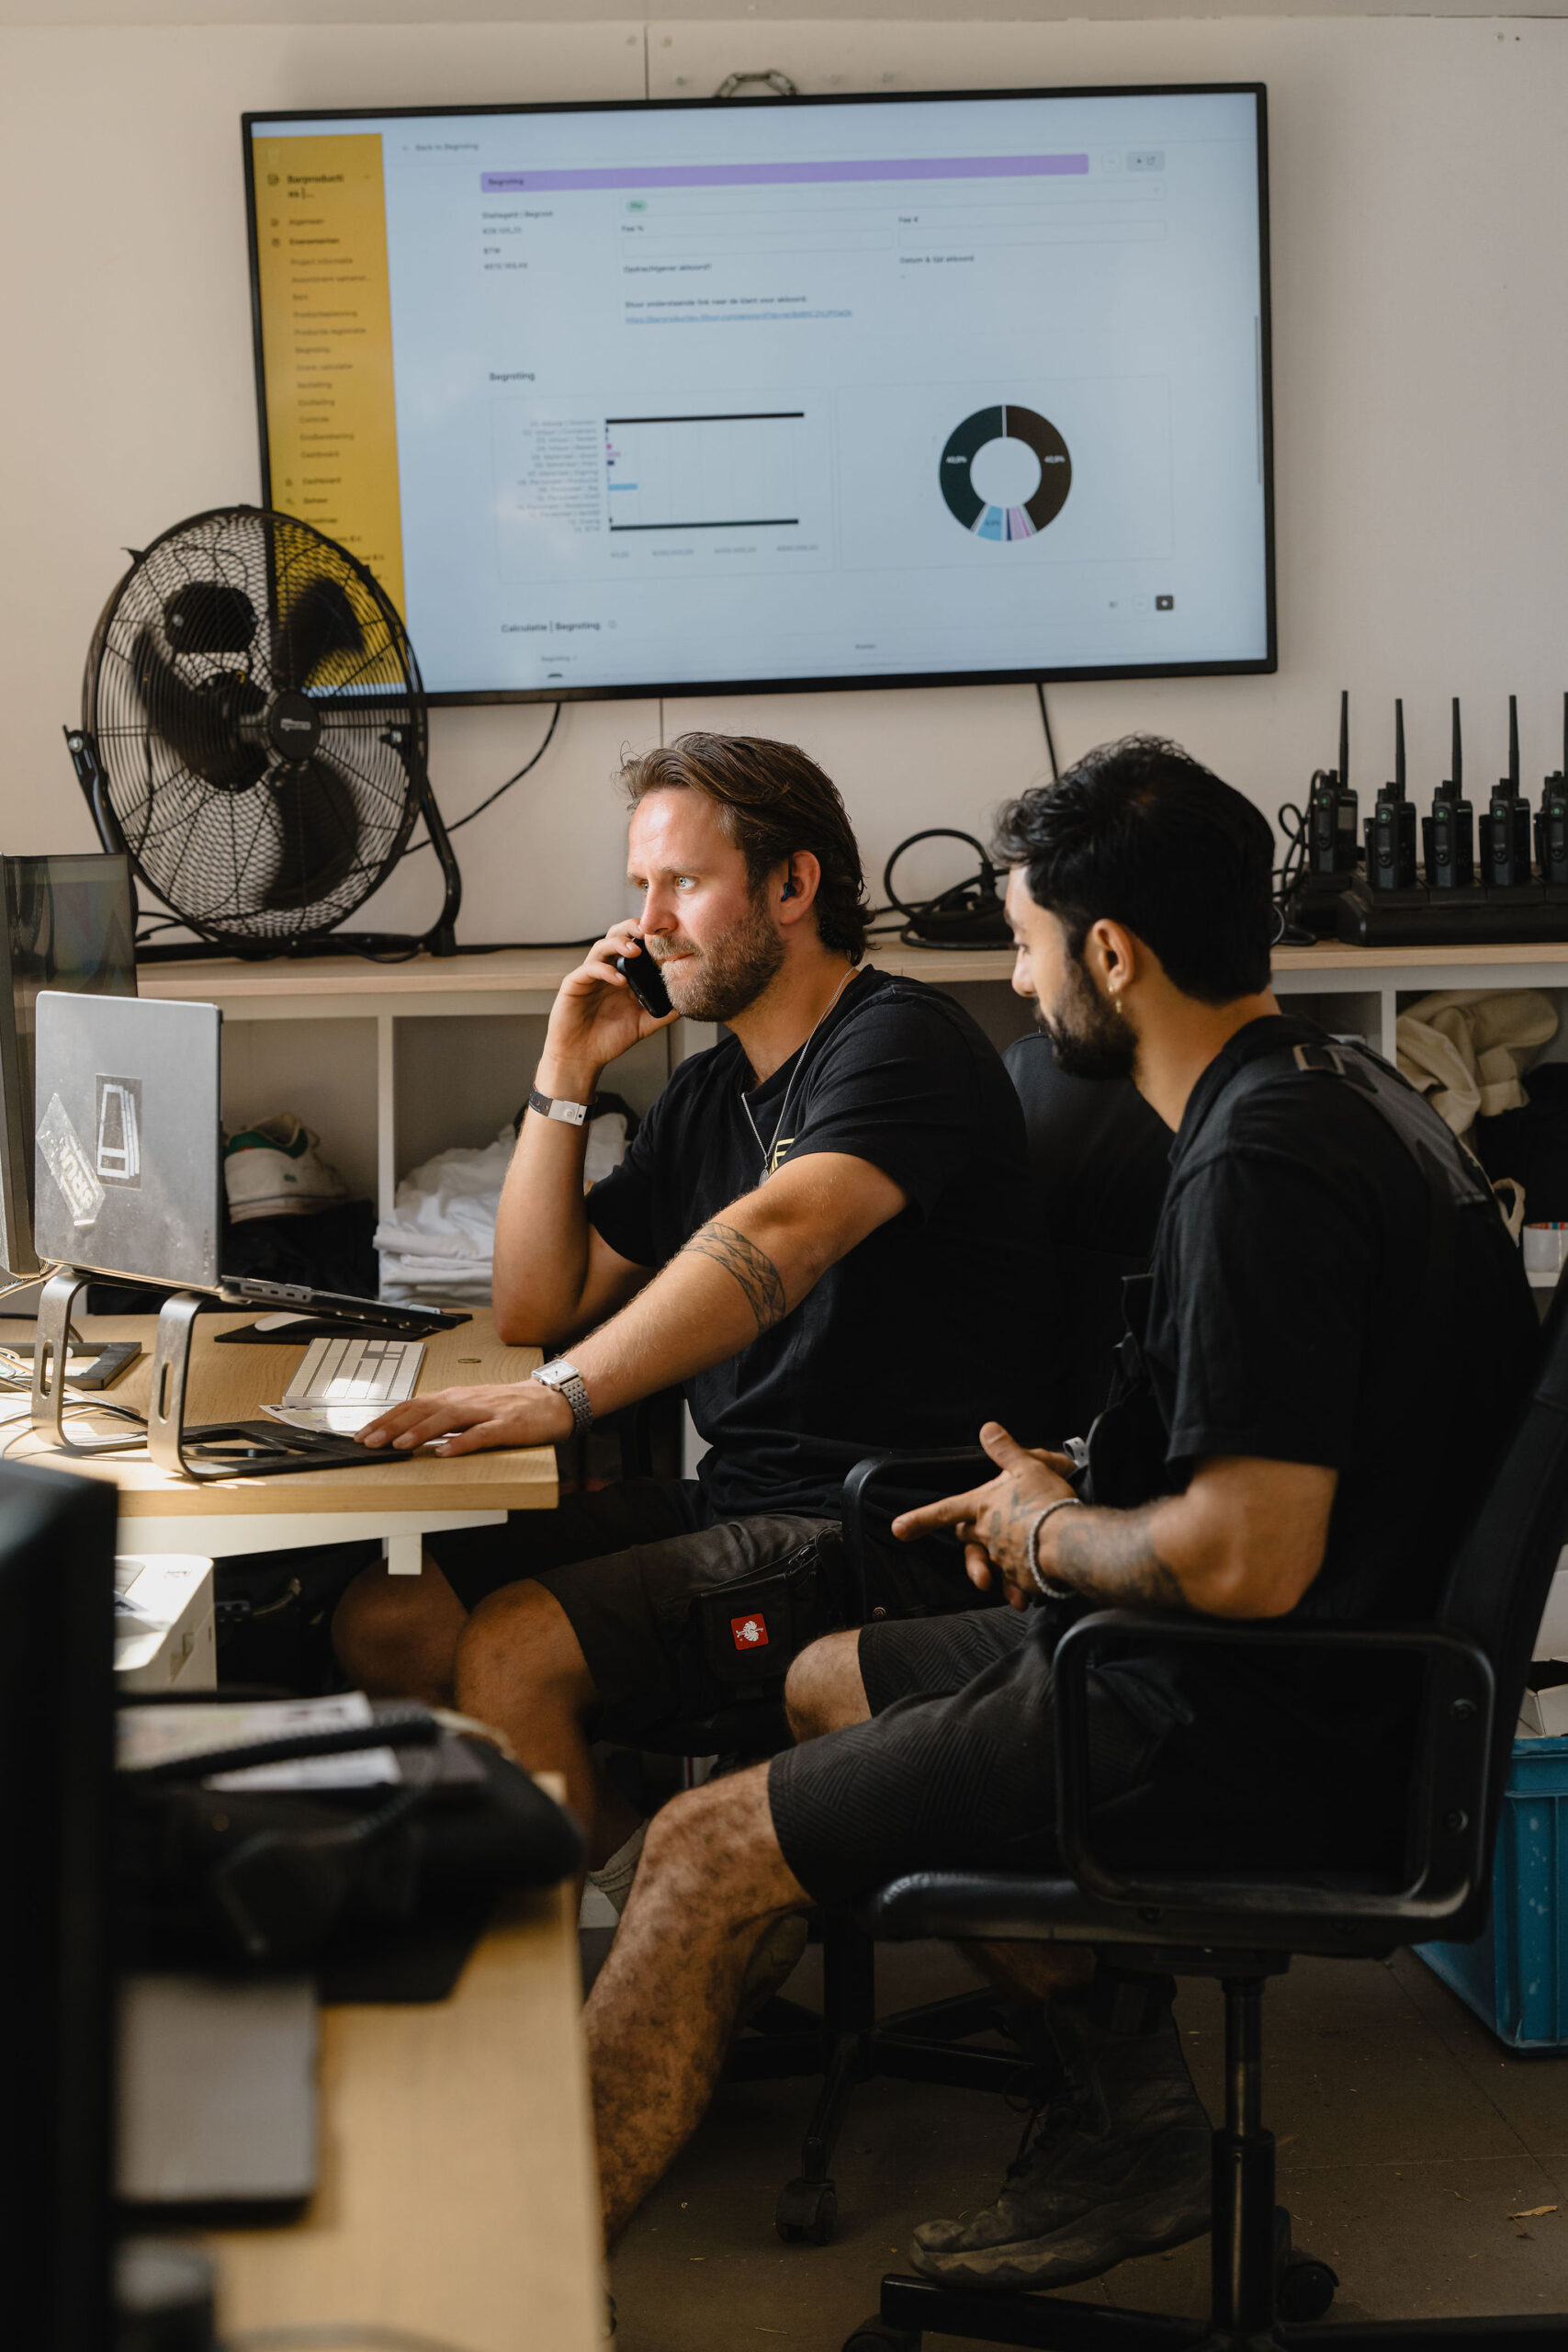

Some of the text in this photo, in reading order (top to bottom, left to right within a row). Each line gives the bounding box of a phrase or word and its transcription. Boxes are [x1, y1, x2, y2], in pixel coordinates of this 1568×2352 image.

[489, 372, 536, 382] Begroting
[501, 623, 547, 633] Calculatie
[555, 621, 601, 631] Begroting
